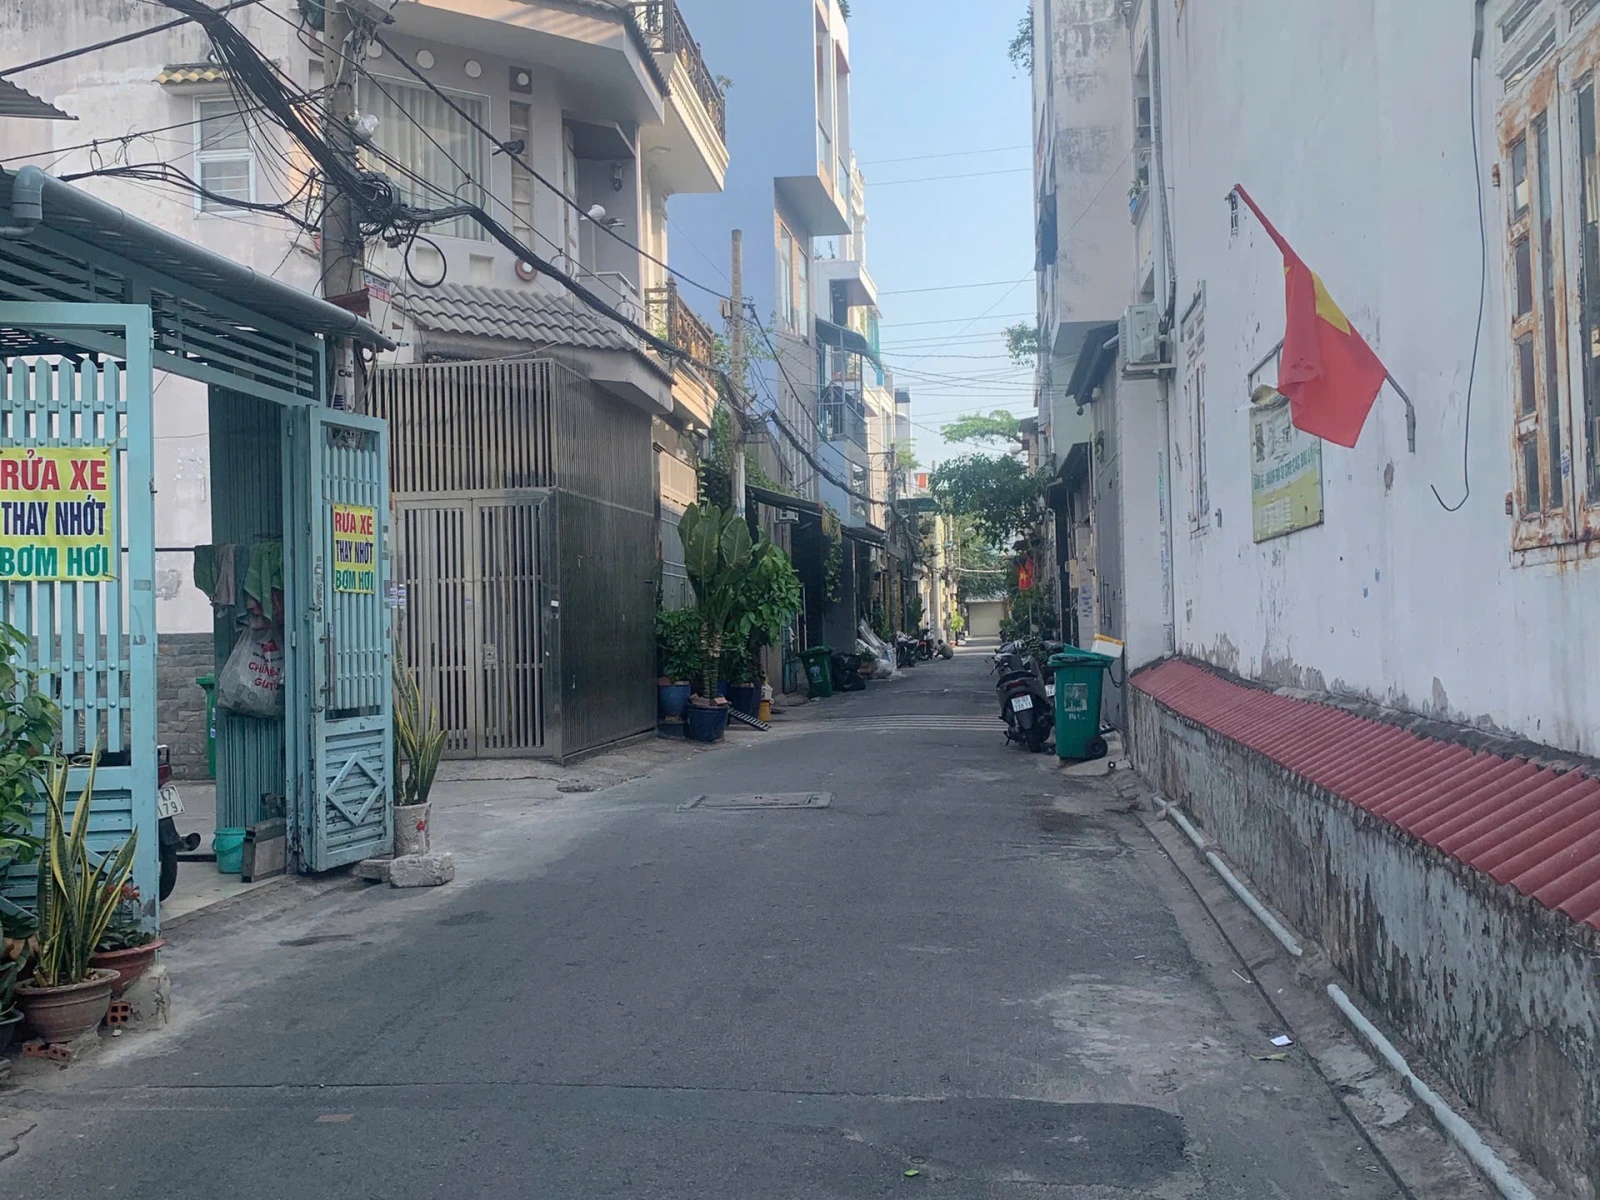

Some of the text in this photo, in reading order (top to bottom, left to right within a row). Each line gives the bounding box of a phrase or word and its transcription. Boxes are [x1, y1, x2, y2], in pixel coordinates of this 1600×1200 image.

[1, 449, 107, 490] RỬA XE
[2, 495, 106, 535] THAY NHỚT
[335, 506, 373, 535] RỬA XE
[0, 544, 109, 577] BƠM HƠI
[336, 538, 373, 564] THAY NHỚT
[336, 568, 373, 590] BƠM HƠI
